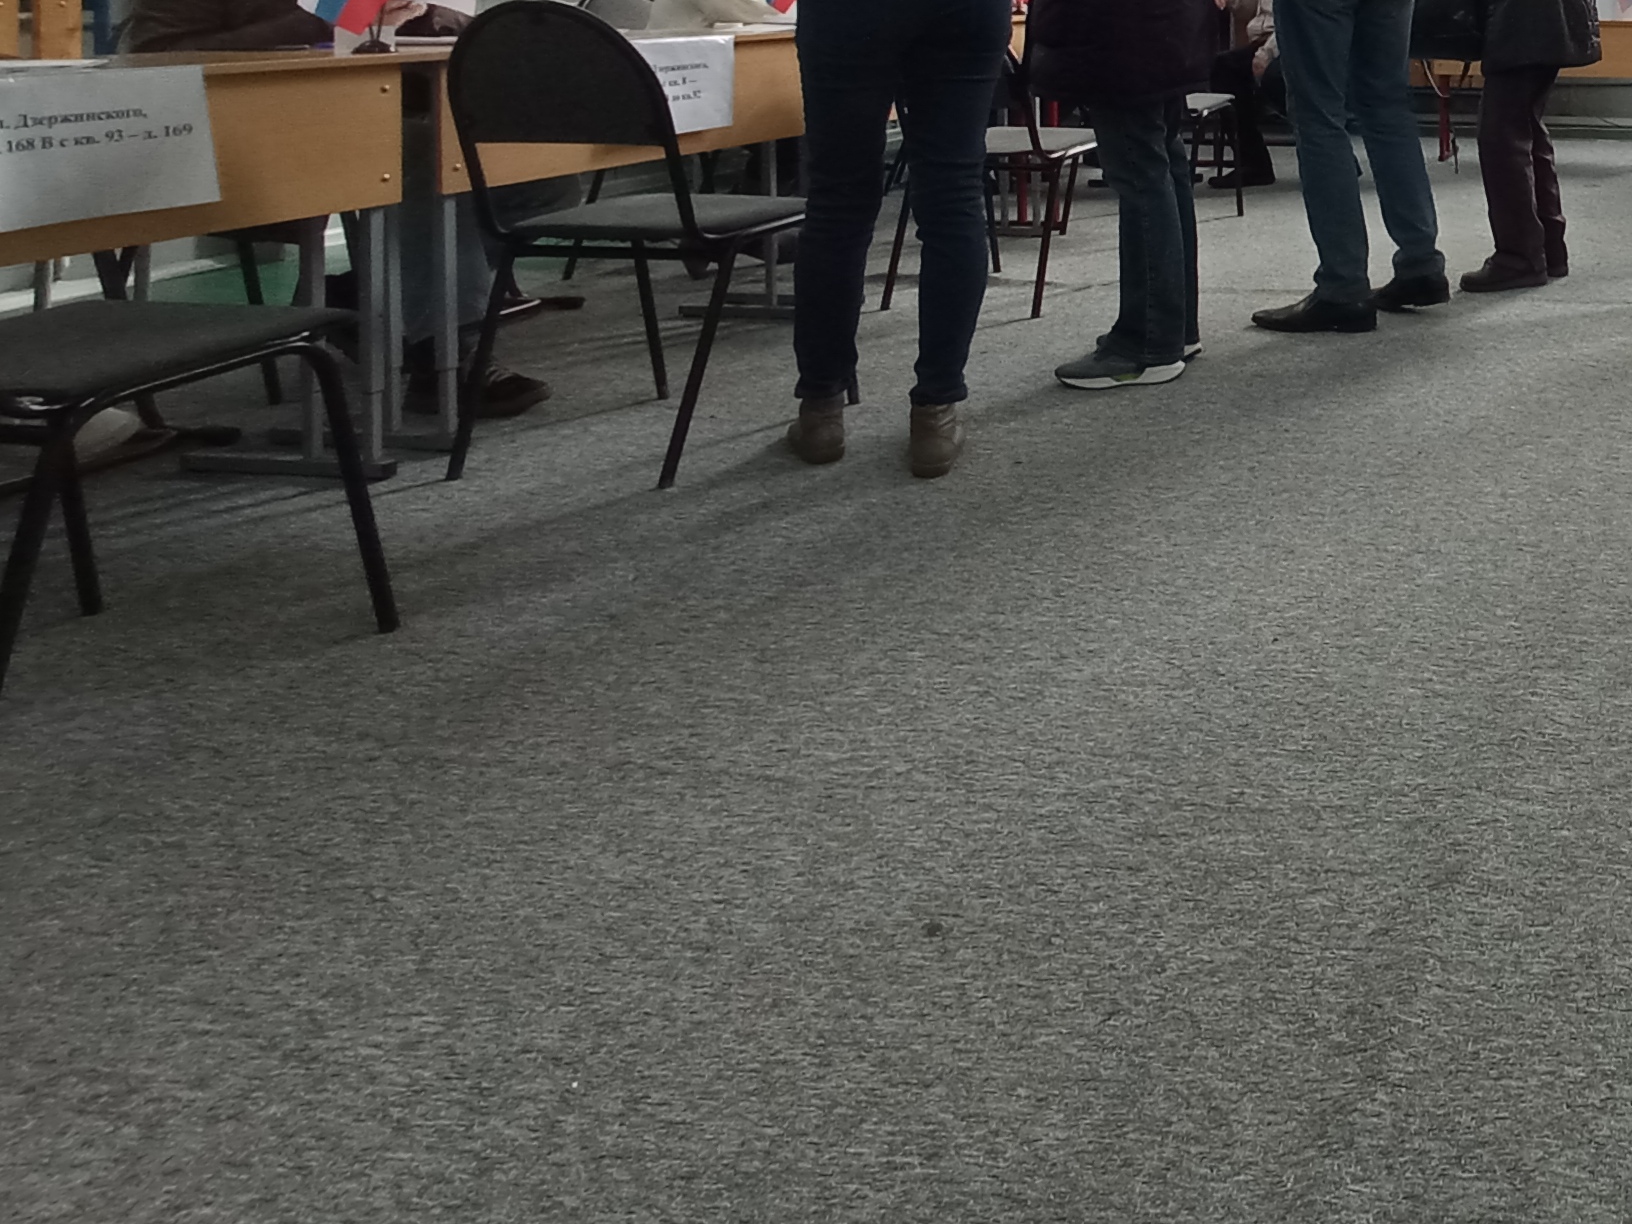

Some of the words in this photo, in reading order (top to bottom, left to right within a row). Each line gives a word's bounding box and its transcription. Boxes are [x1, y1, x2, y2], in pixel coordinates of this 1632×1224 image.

[14, 108, 148, 130] Дзержинского,
[6, 137, 36, 153] 168
[74, 135, 100, 146] кв.
[105, 129, 124, 143] 93
[163, 123, 193, 137] 169
